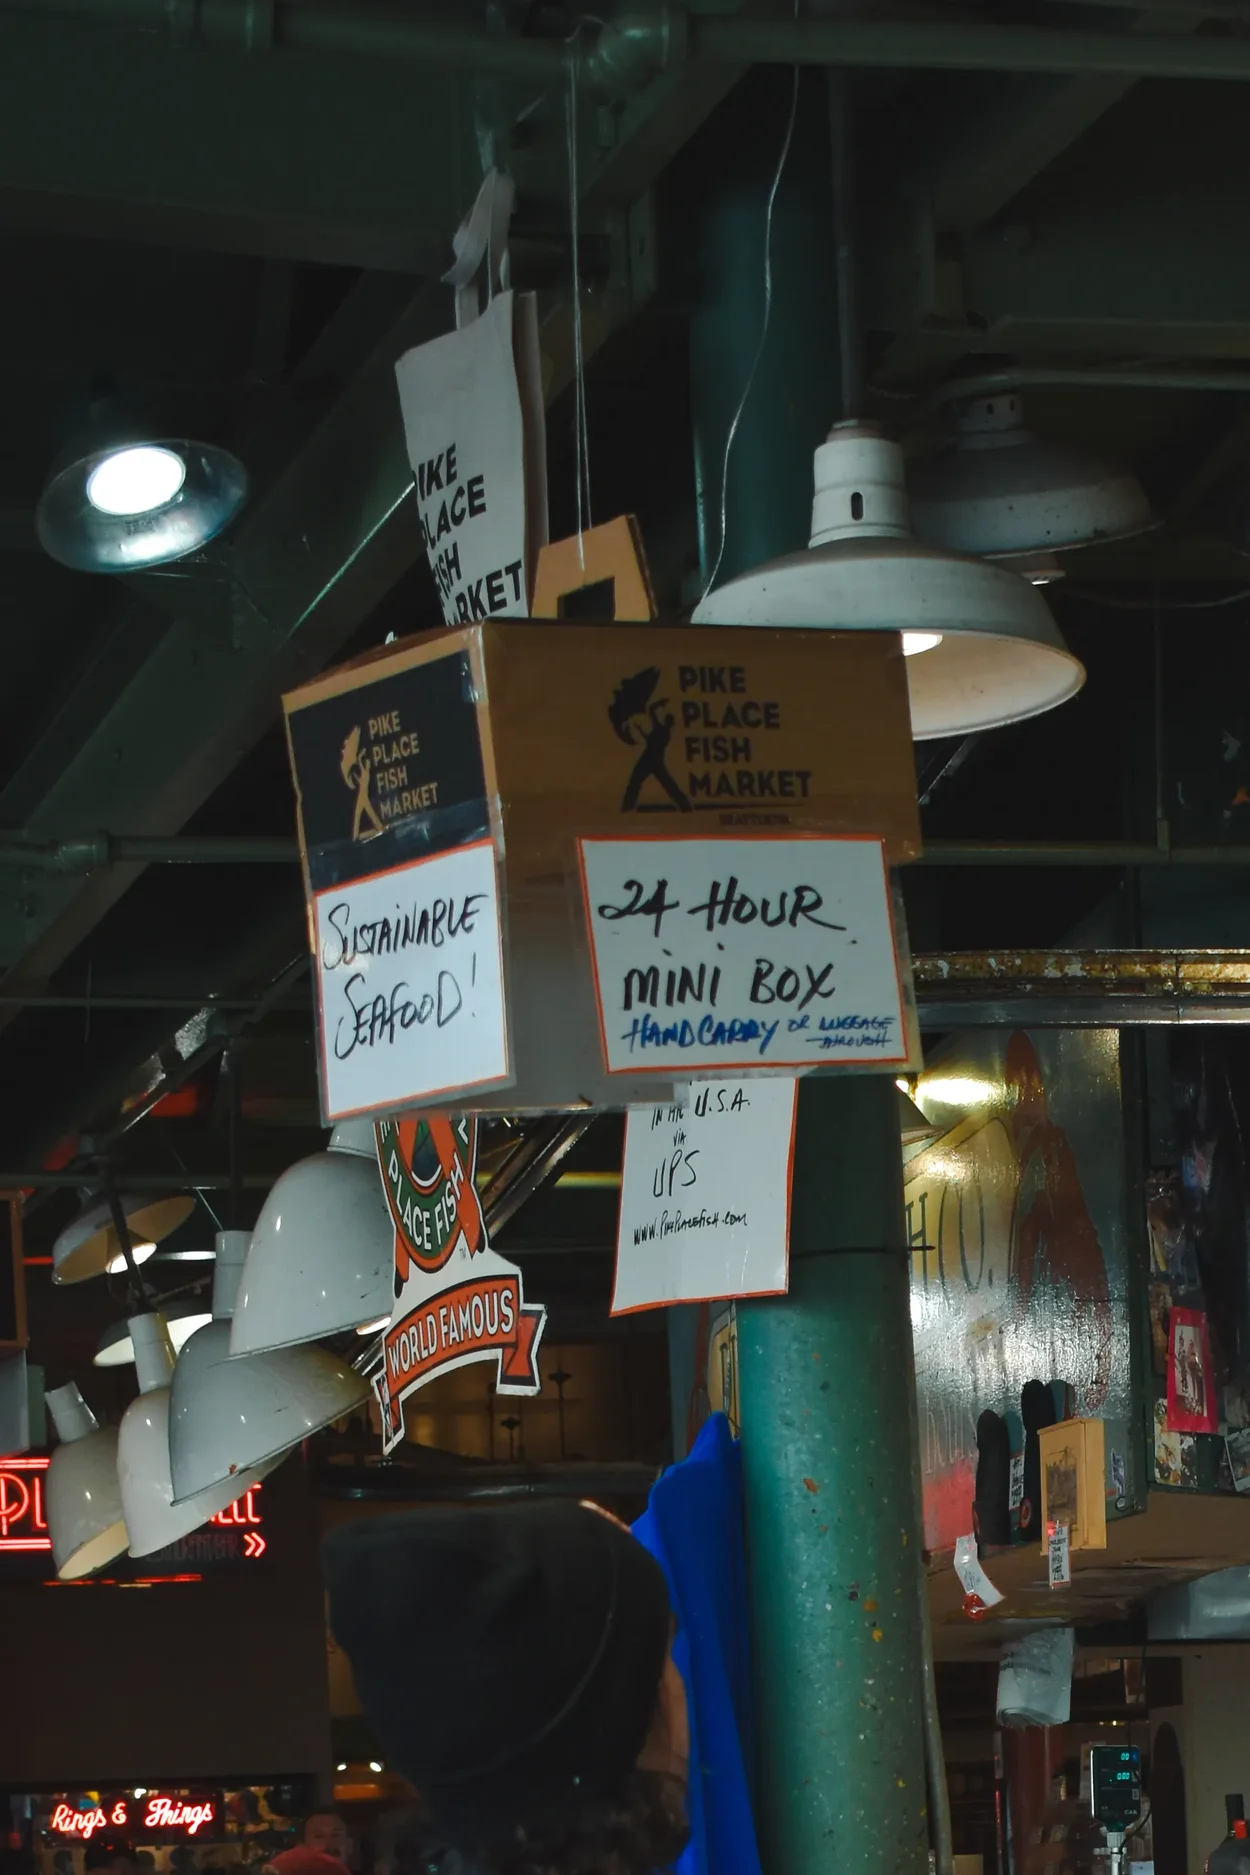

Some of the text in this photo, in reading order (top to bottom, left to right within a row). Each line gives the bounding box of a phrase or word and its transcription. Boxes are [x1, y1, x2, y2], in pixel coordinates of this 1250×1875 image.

[440, 559, 522, 626] RKET
[678, 666, 747, 693] PIKE
[368, 711, 401, 740] PIKE
[681, 701, 780, 729] PLACE
[372, 733, 420, 766] PLACE
[684, 736, 752, 763] FISH
[376, 765, 408, 794] FISH
[688, 769, 812, 798] MARKET
[379, 782, 439, 820] MARKET
[598, 878, 680, 938] 24
[323, 894, 488, 970] SUSTAINABLE
[623, 942, 836, 1011] MINI BOX
[787, 1014, 810, 1032] OR
[653, 1149, 700, 1198] UPS
[388, 1150, 464, 1250] PLACE FISH
[389, 1289, 514, 1377] WORLD FAMOUS
[52, 1798, 213, 1839] Rings & Things
